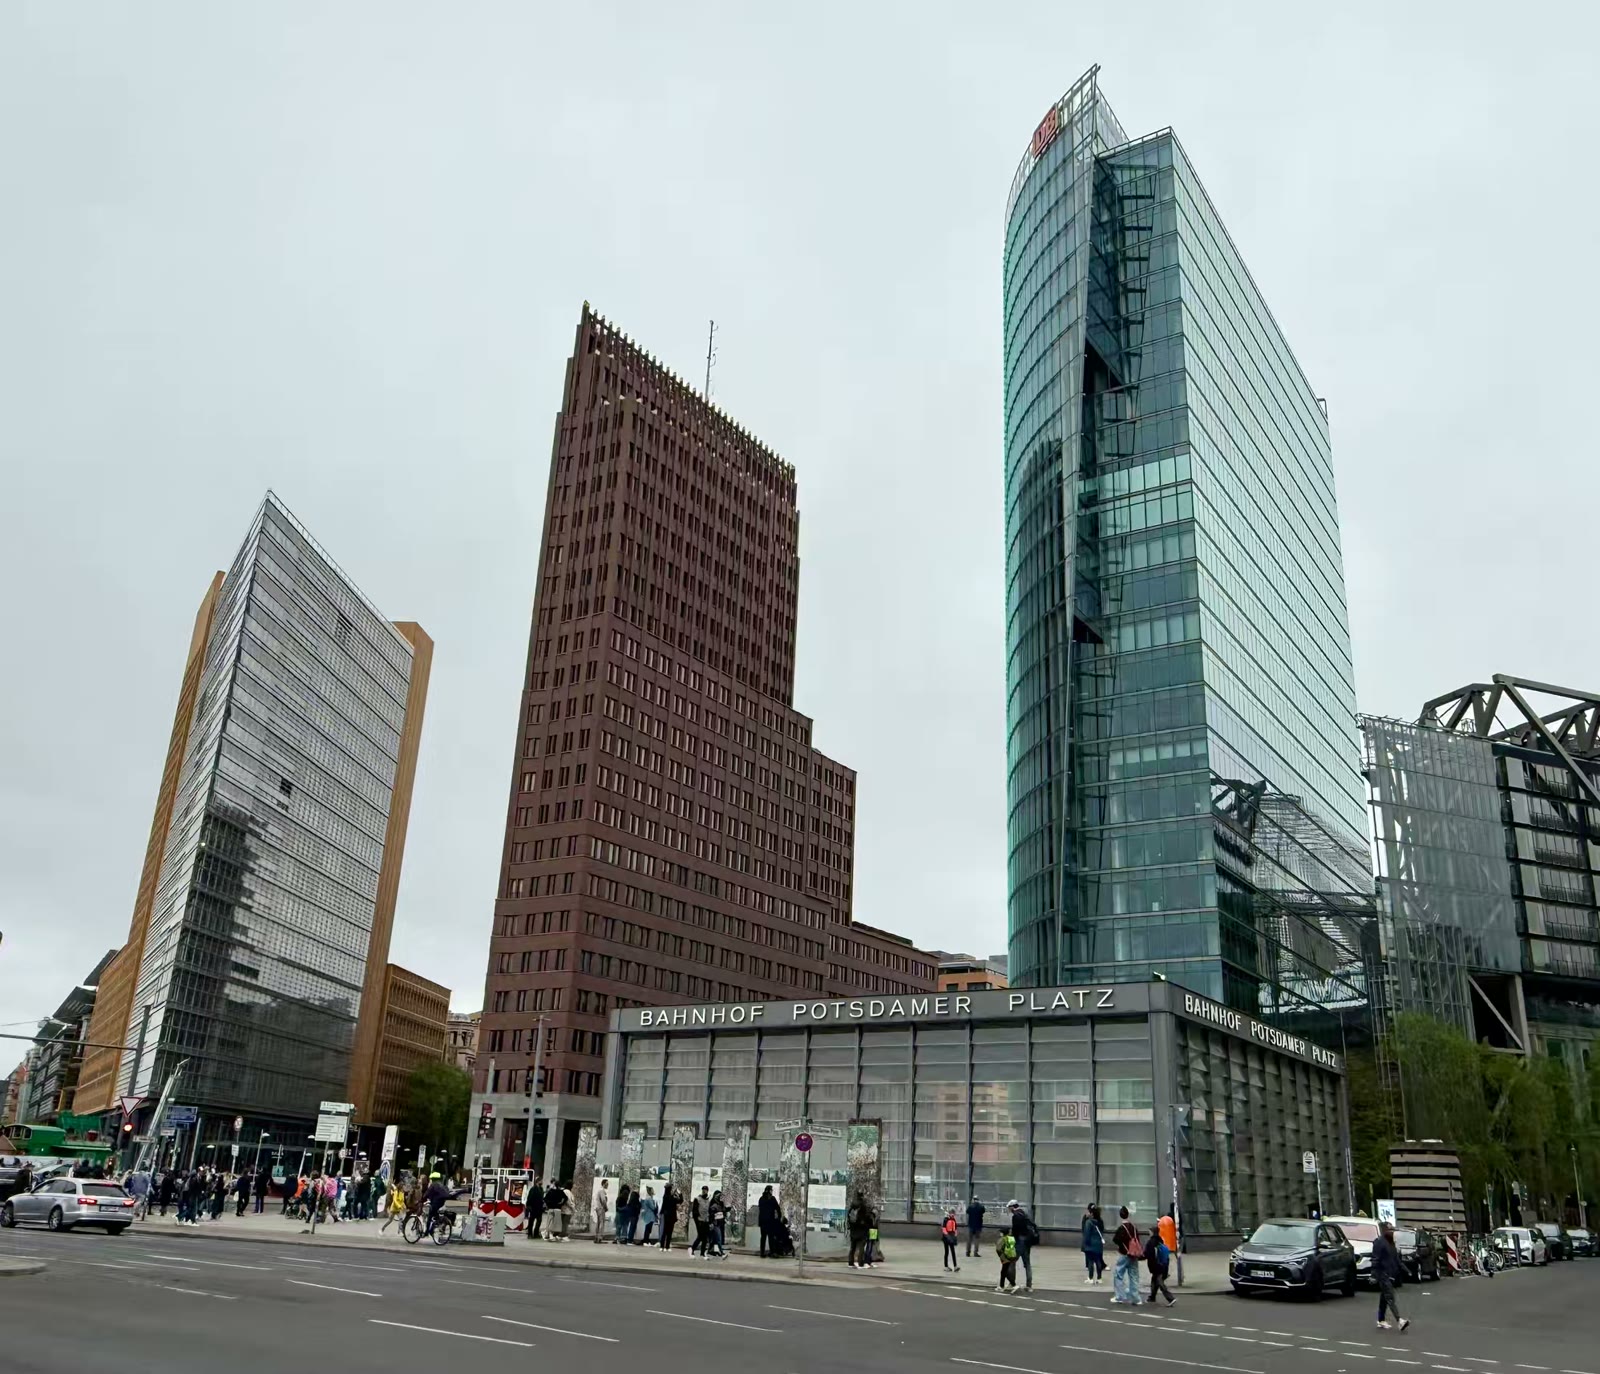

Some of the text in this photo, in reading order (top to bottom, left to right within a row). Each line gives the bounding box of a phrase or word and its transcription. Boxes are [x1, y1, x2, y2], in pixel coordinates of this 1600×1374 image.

[1034, 111, 1057, 150] DB
[640, 988, 1115, 1027] BAHNHOF POTSDAMER PLATZ
[1185, 994, 1337, 1069] BAHNHOF POTSDAMER PLATZ
[1058, 1103, 1076, 1118] DB
